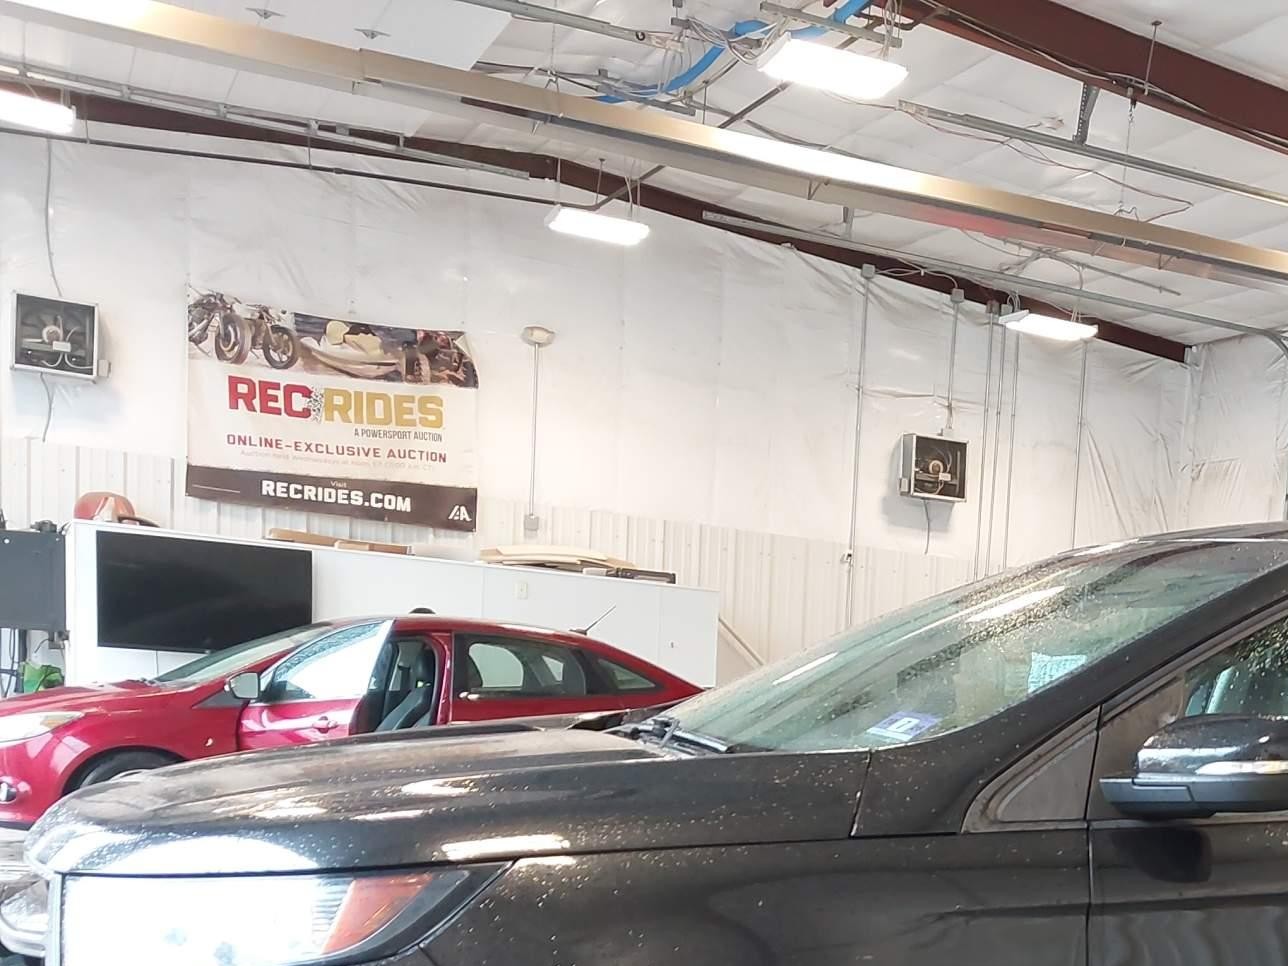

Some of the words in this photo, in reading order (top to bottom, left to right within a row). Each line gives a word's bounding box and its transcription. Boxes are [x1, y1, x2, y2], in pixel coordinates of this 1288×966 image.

[228, 375, 313, 419] REC
[324, 388, 444, 429] RIDES
[226, 433, 382, 458] ONLINE-EXCLUSIVE
[386, 448, 447, 463] AUCTION
[354, 428, 360, 437] A
[361, 428, 412, 440] POWERSPORT
[413, 431, 443, 443] AUCTION
[261, 479, 412, 513] RECRIDES.COM
[330, 480, 347, 488] Visit
